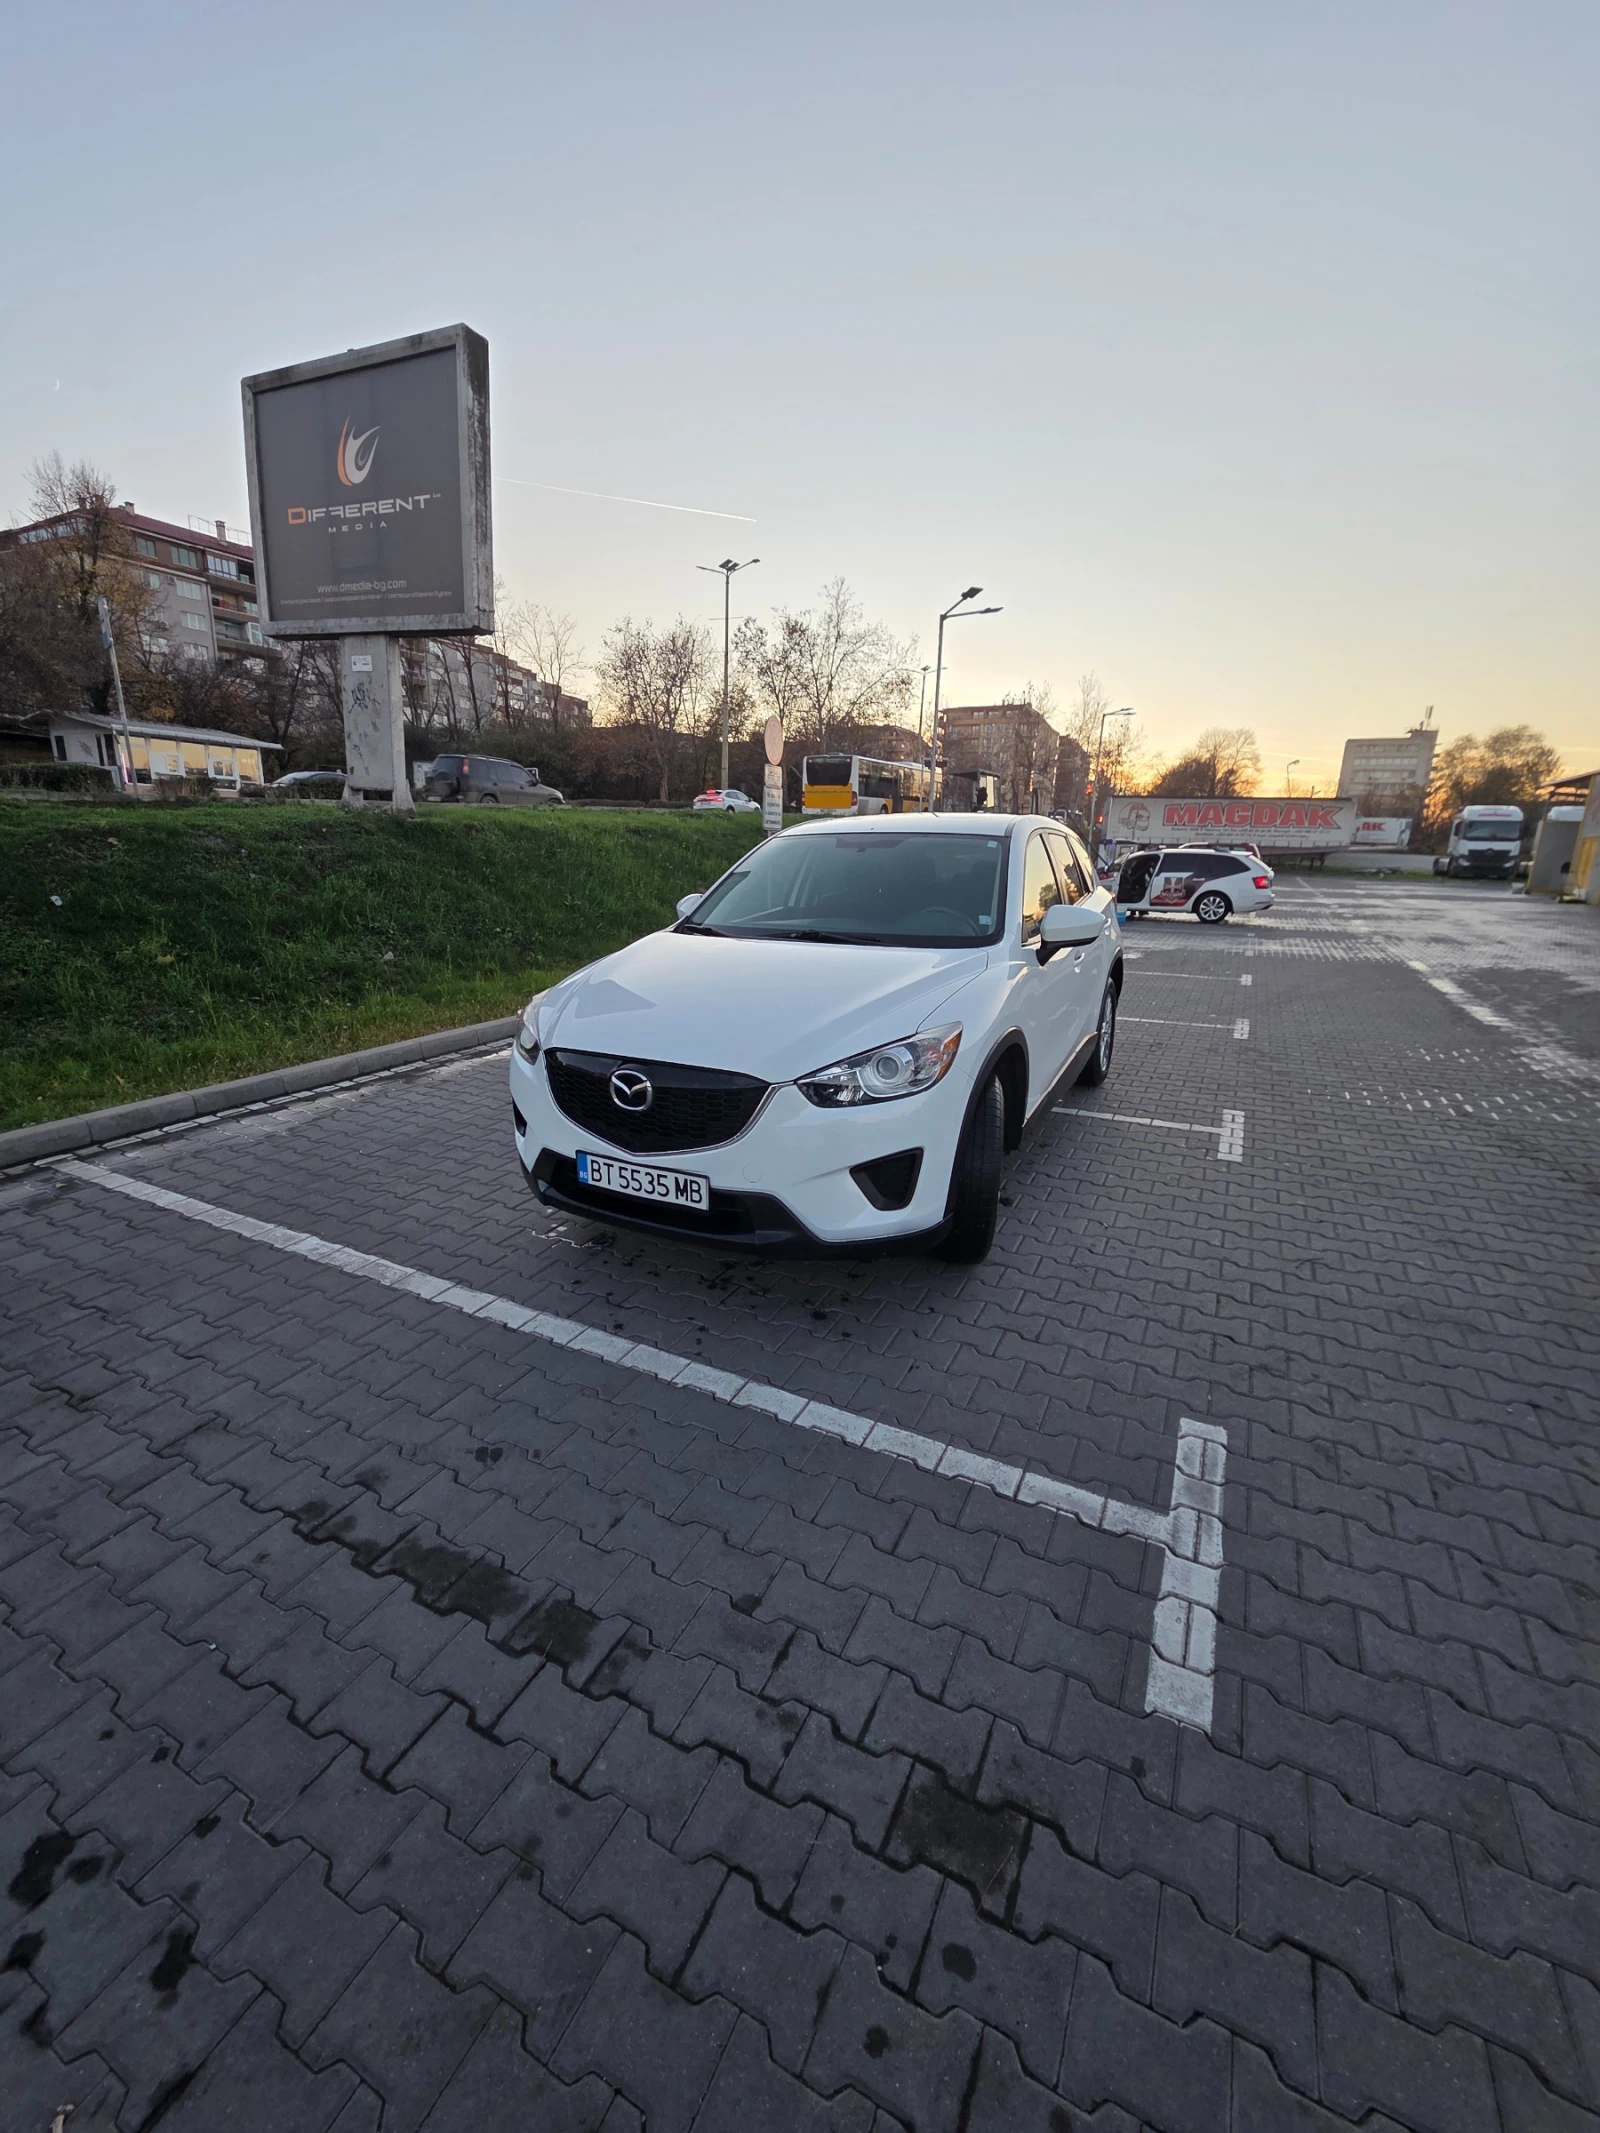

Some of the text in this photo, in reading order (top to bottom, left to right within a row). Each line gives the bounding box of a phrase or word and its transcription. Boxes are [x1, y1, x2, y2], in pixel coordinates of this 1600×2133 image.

[287, 494, 430, 525] DIFFERENT
[328, 520, 388, 534] MEDIA
[317, 578, 407, 595] www.dmedia-bg.com
[1162, 801, 1344, 830] MAGDAK
[579, 1170, 588, 1180] BG
[590, 1159, 703, 1205] BT 5535 MB
